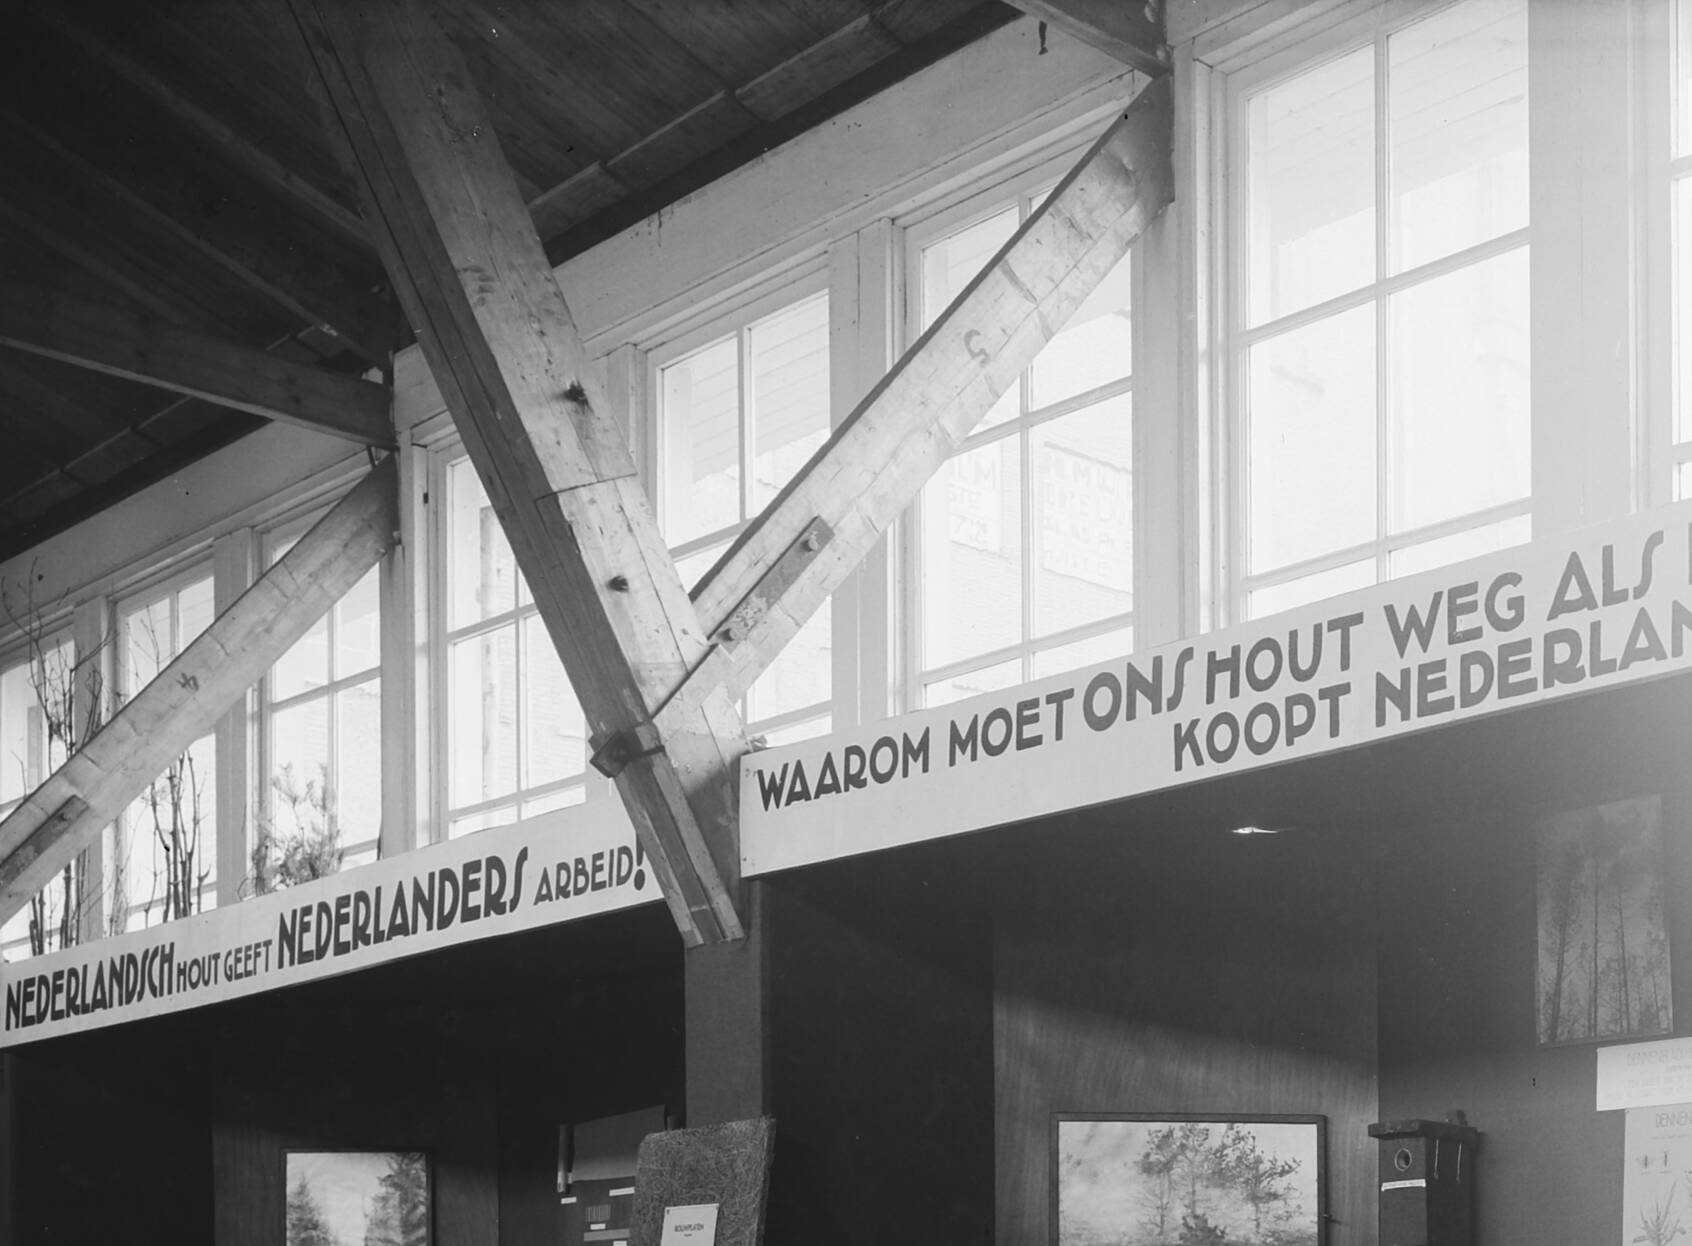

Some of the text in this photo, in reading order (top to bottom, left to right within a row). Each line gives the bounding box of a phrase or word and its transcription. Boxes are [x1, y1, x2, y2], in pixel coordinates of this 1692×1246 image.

[755, 725, 930, 813] WAAROM
[948, 687, 1075, 768] MOET
[1082, 646, 1194, 733] ONS
[1206, 611, 1364, 705] HOUT
[1383, 571, 1525, 660] WEG
[1546, 529, 1665, 622] ALS
[1172, 682, 1351, 772] KOOPT
[4, 843, 646, 1031] NEDERLANDSCH HOUT GEEFT NEDERLANDERS ARBEID!
